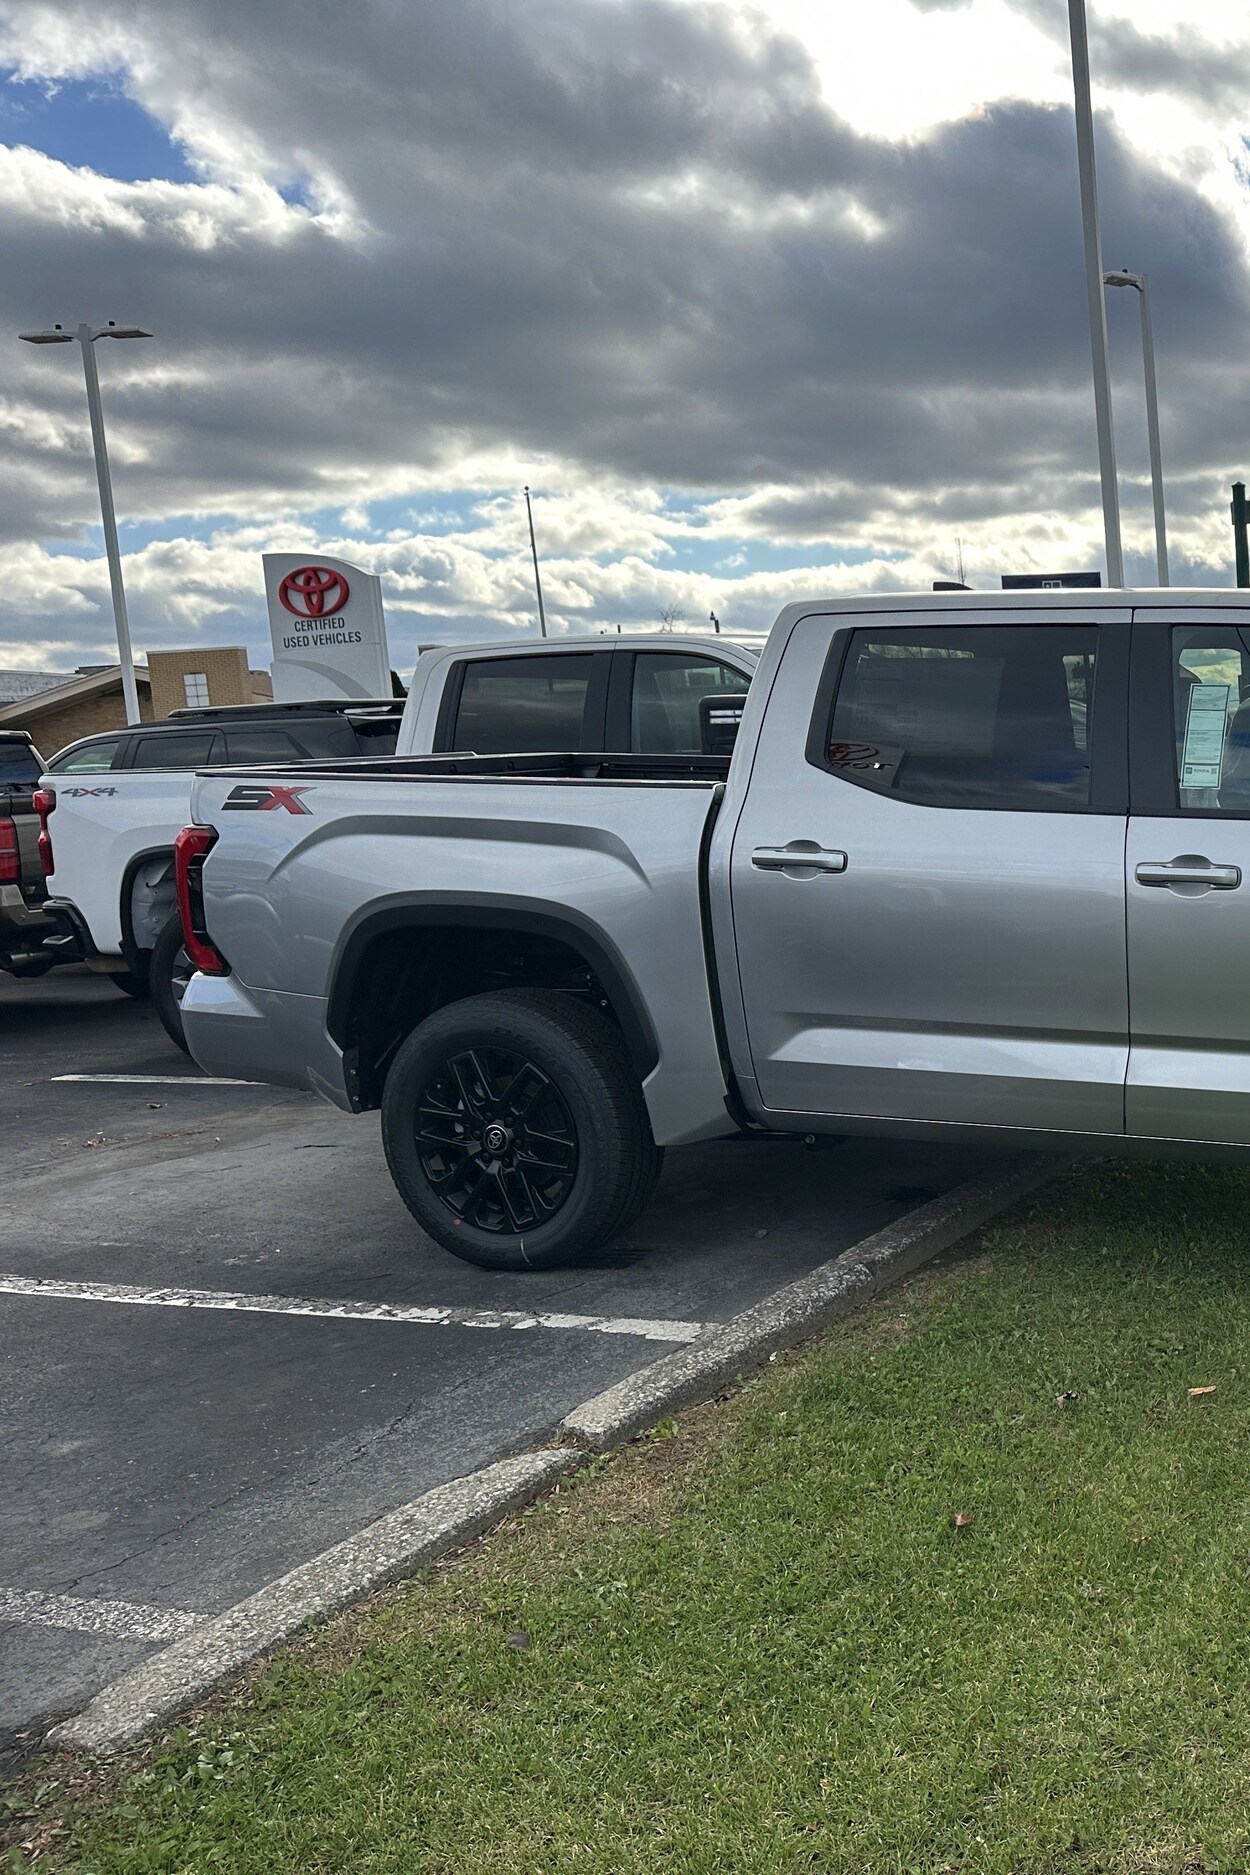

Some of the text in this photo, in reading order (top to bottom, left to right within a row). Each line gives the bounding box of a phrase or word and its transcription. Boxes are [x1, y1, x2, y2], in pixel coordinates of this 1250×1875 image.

[294, 617, 345, 632] CERTIFIED
[283, 631, 362, 649] USED VEHICLES
